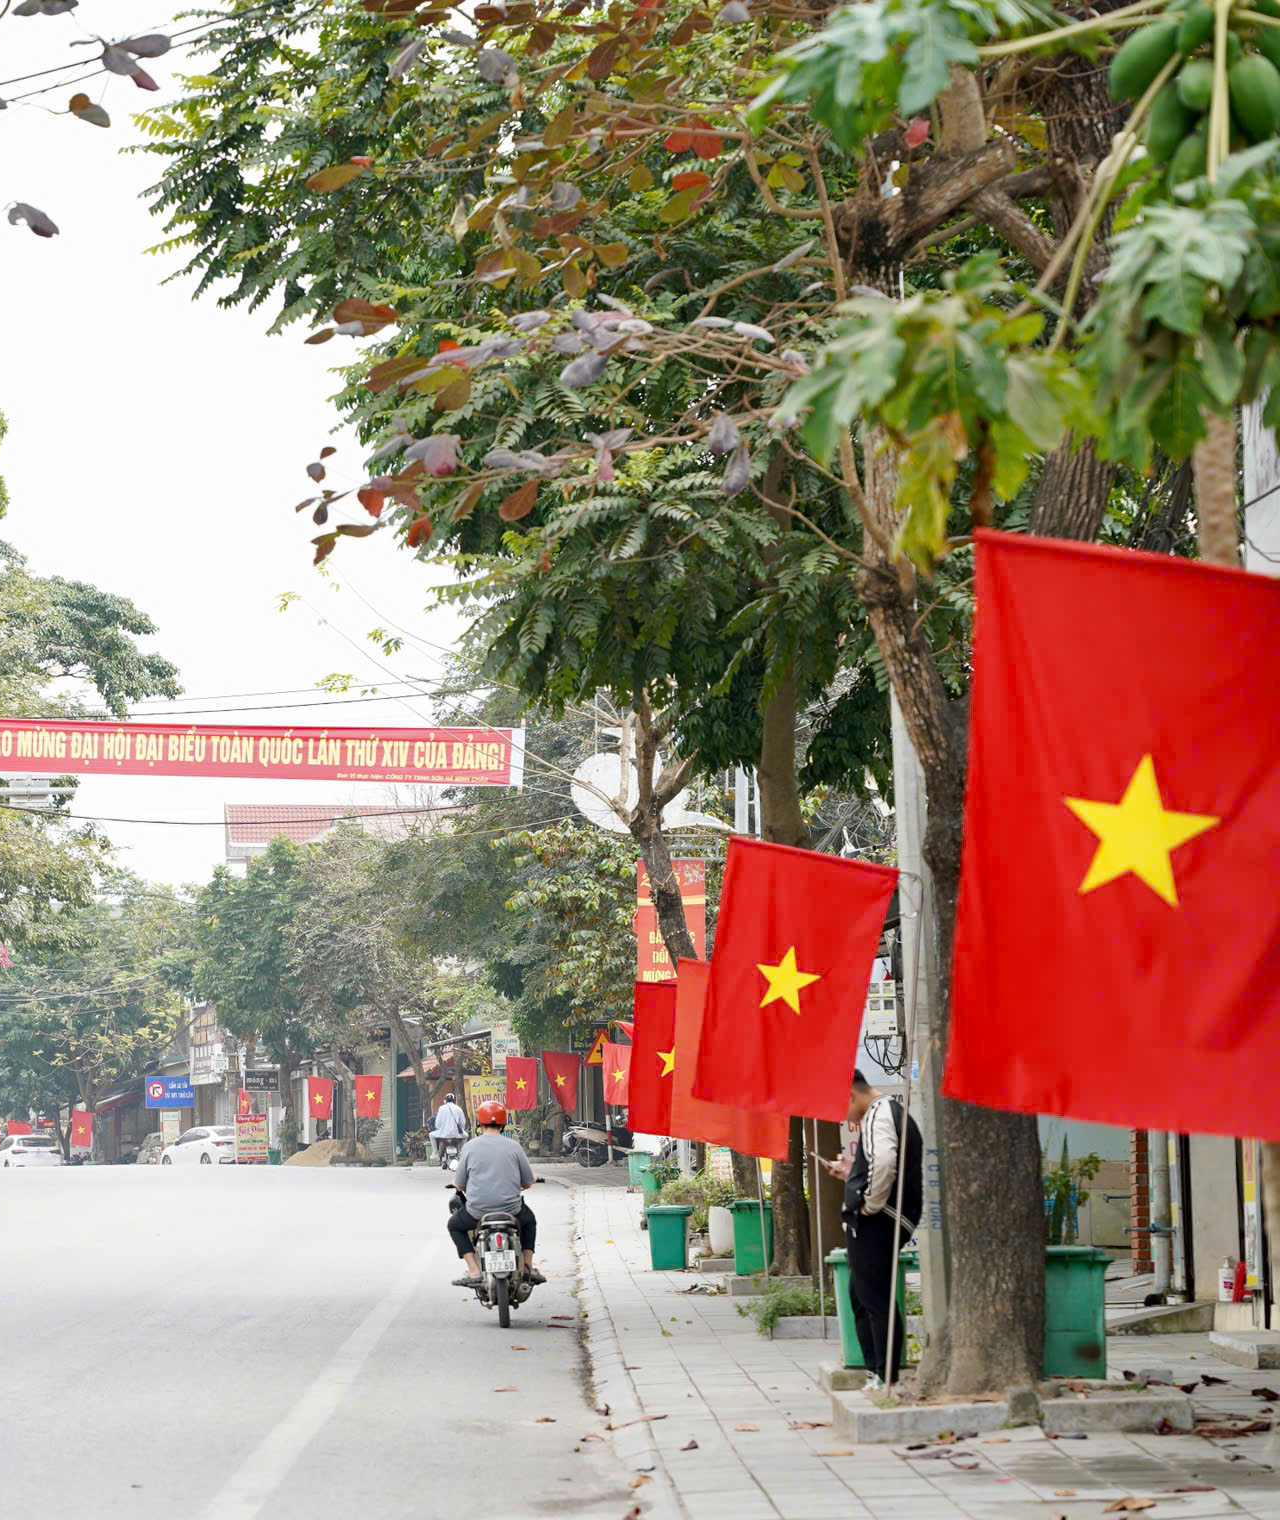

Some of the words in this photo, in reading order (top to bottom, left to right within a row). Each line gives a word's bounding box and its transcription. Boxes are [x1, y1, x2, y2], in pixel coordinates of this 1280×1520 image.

[17, 725, 66, 759] MỪNG
[71, 731, 98, 766] ĐẠI
[103, 728, 131, 766] HỘI
[136, 733, 163, 767] ĐẠI
[168, 725, 206, 763] BIỂU
[211, 731, 254, 764] TOÀN
[258, 728, 303, 767] QUỐC
[307, 729, 341, 766] LẦN
[346, 733, 380, 767] THỨ
[381, 740, 409, 769] XIV
[413, 732, 448, 769] CỦA
[452, 734, 505, 771] ĐẢNG!
